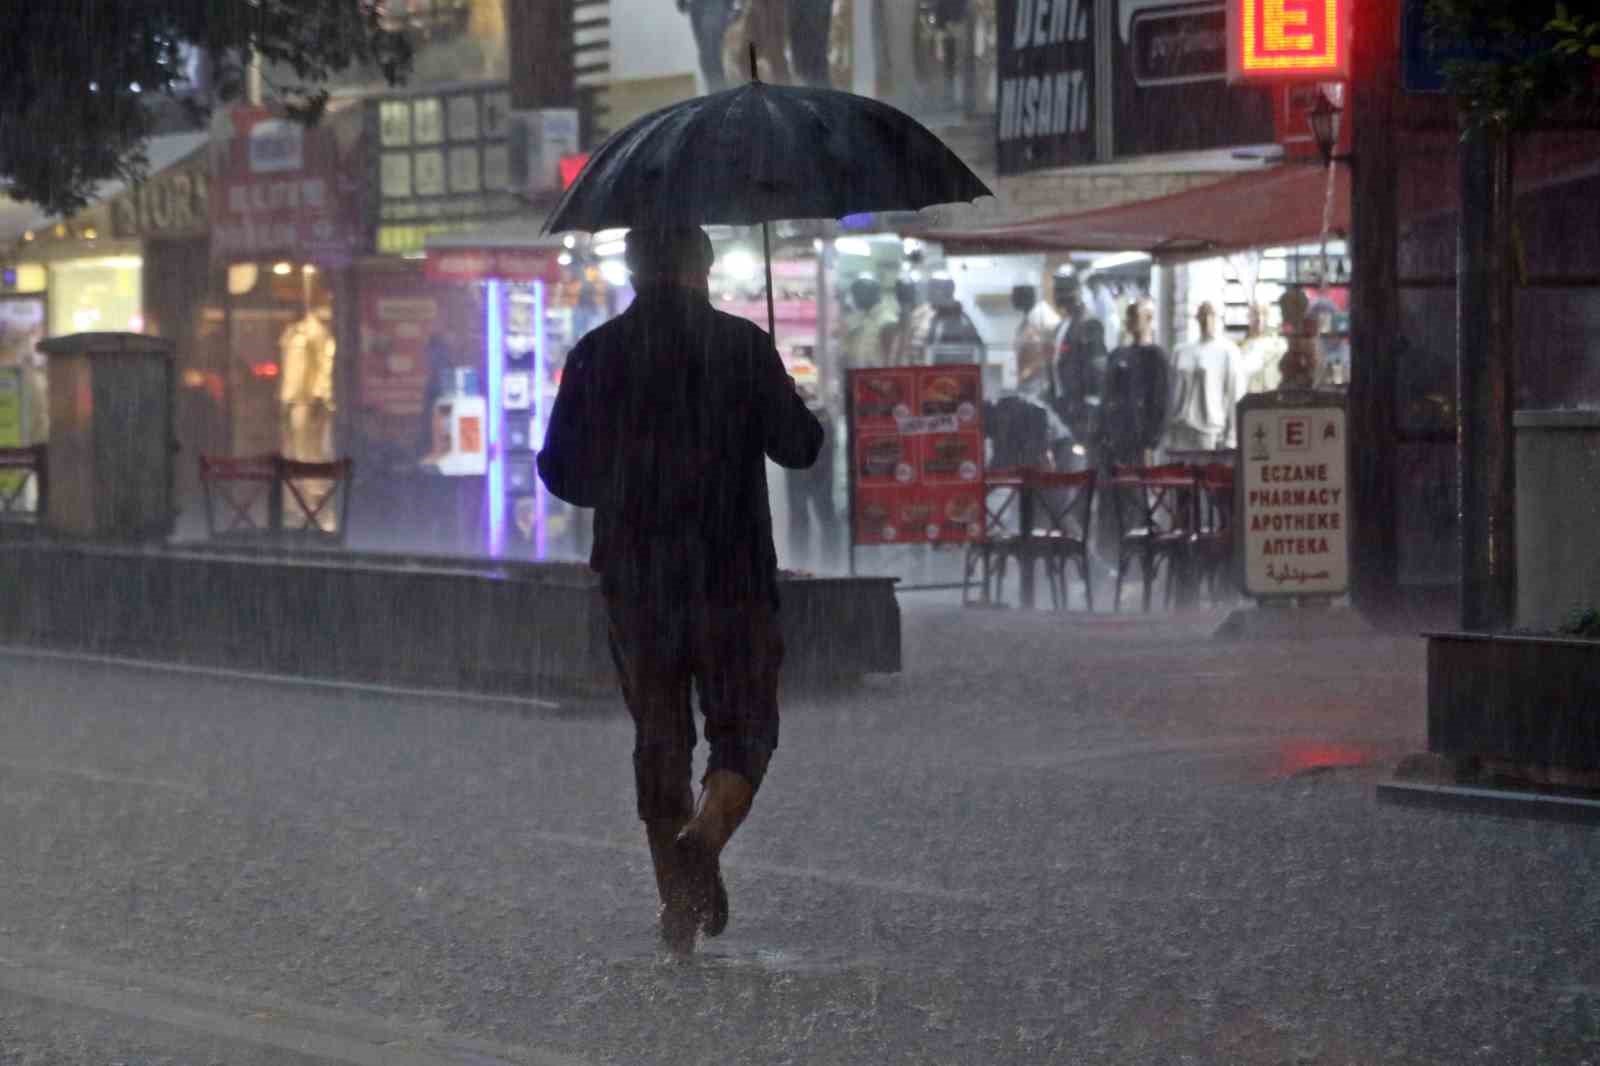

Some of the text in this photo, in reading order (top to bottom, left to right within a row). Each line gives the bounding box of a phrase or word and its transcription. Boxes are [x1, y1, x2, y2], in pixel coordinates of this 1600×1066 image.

[1263, 0, 1313, 50] E
[1285, 422, 1304, 446] E
[1260, 464, 1328, 483] ECZANE
[1249, 489, 1341, 506] PHARMACY
[1250, 513, 1340, 531] APOTHEKE
